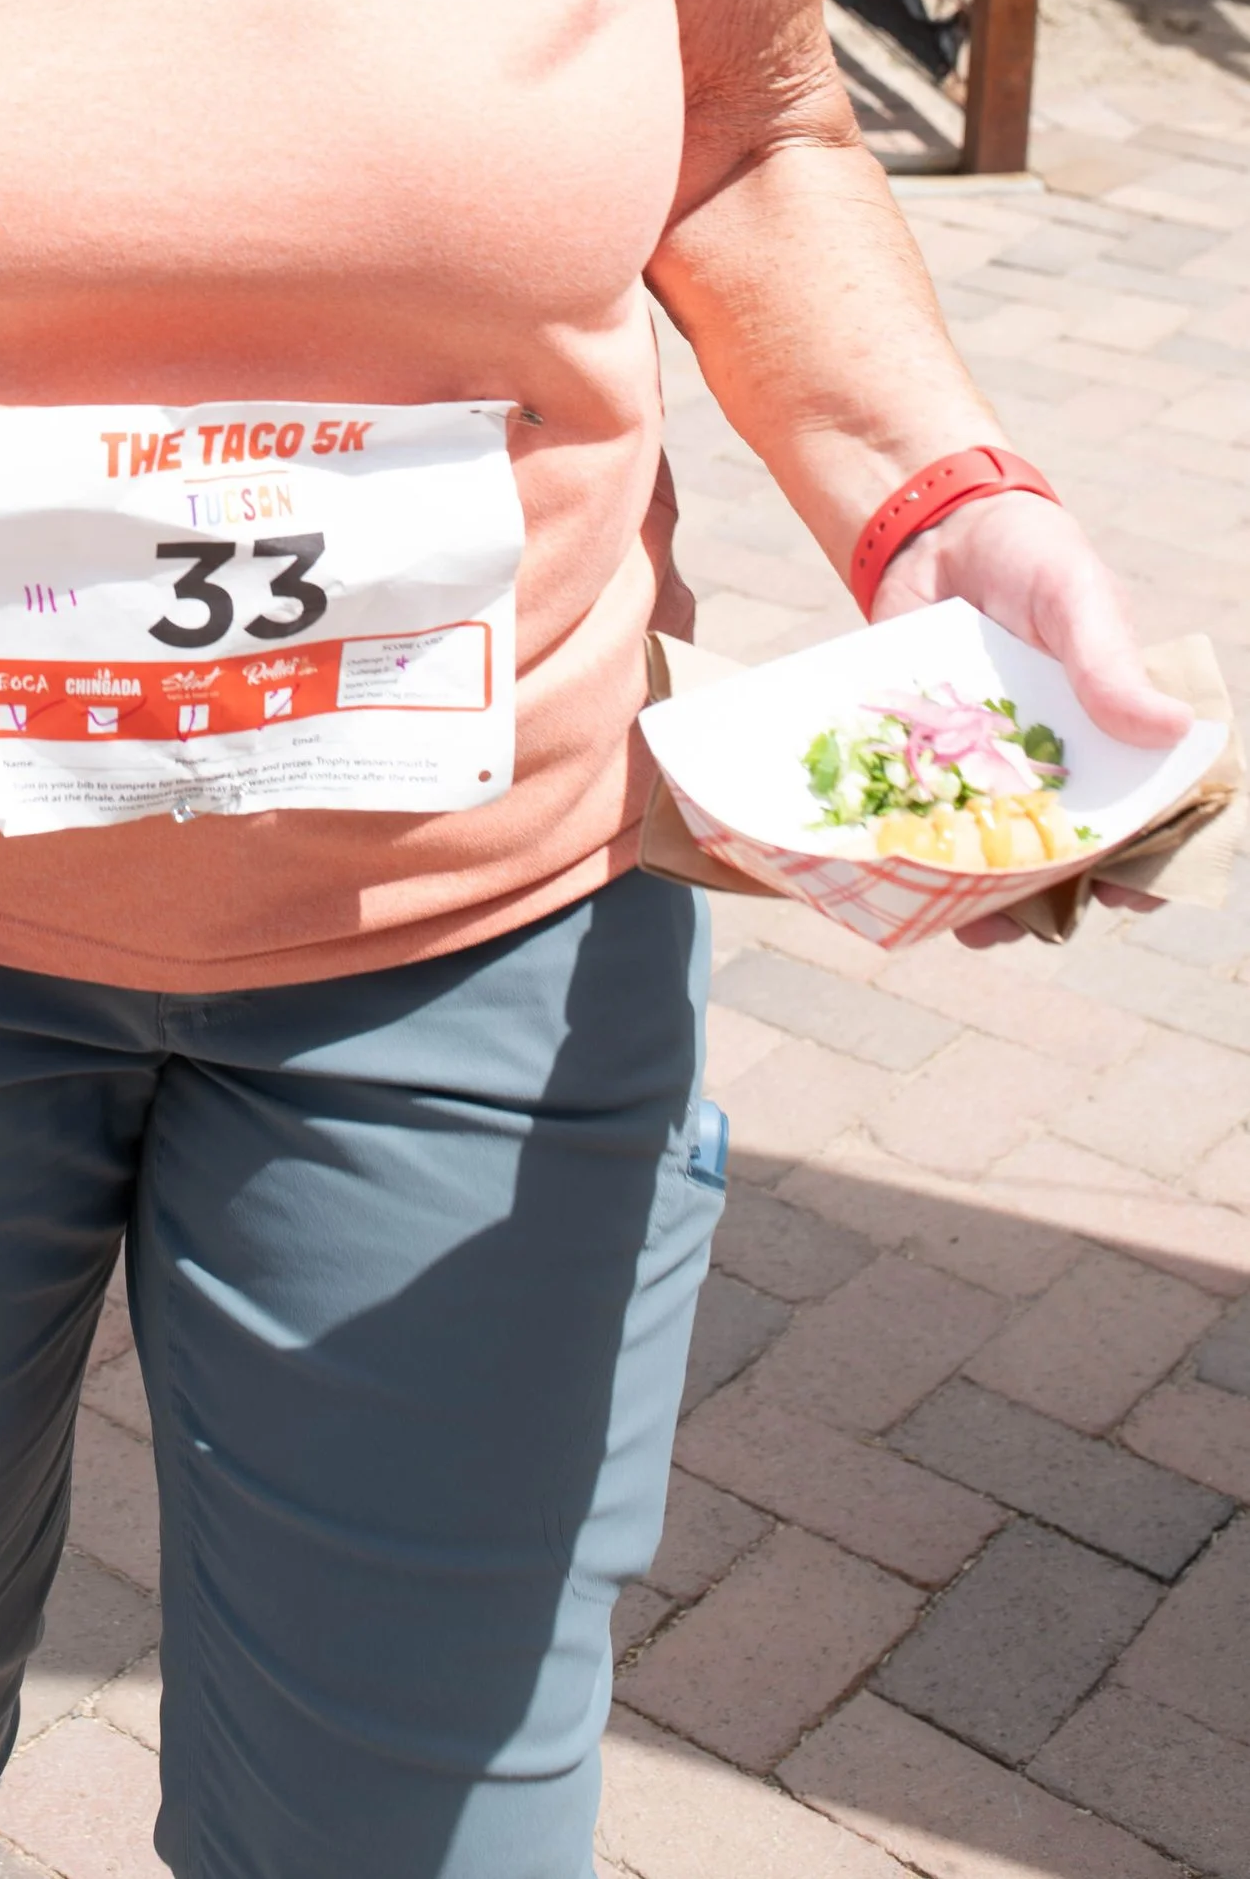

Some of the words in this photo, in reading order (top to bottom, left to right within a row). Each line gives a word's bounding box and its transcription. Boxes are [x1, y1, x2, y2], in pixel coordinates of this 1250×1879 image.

[100, 428, 184, 477] THE
[198, 422, 305, 465] TACO
[311, 420, 374, 455] 5K
[187, 484, 293, 526] TUCSON
[148, 532, 327, 648] 33
[65, 677, 142, 696] CHINGADA
[316, 755, 350, 769] Trophy
[354, 757, 393, 766] winners
[51, 782, 73, 791] your
[77, 780, 94, 790] bib
[97, 782, 108, 790] to
[110, 780, 156, 791] compete
[159, 780, 173, 788] for
[52, 793, 61, 802] at
[65, 792, 82, 802] the
[118, 787, 172, 802] Additional
[288, 771, 307, 782] and
[310, 771, 359, 782] contacted
[362, 771, 385, 782] after
[388, 773, 406, 783] the
